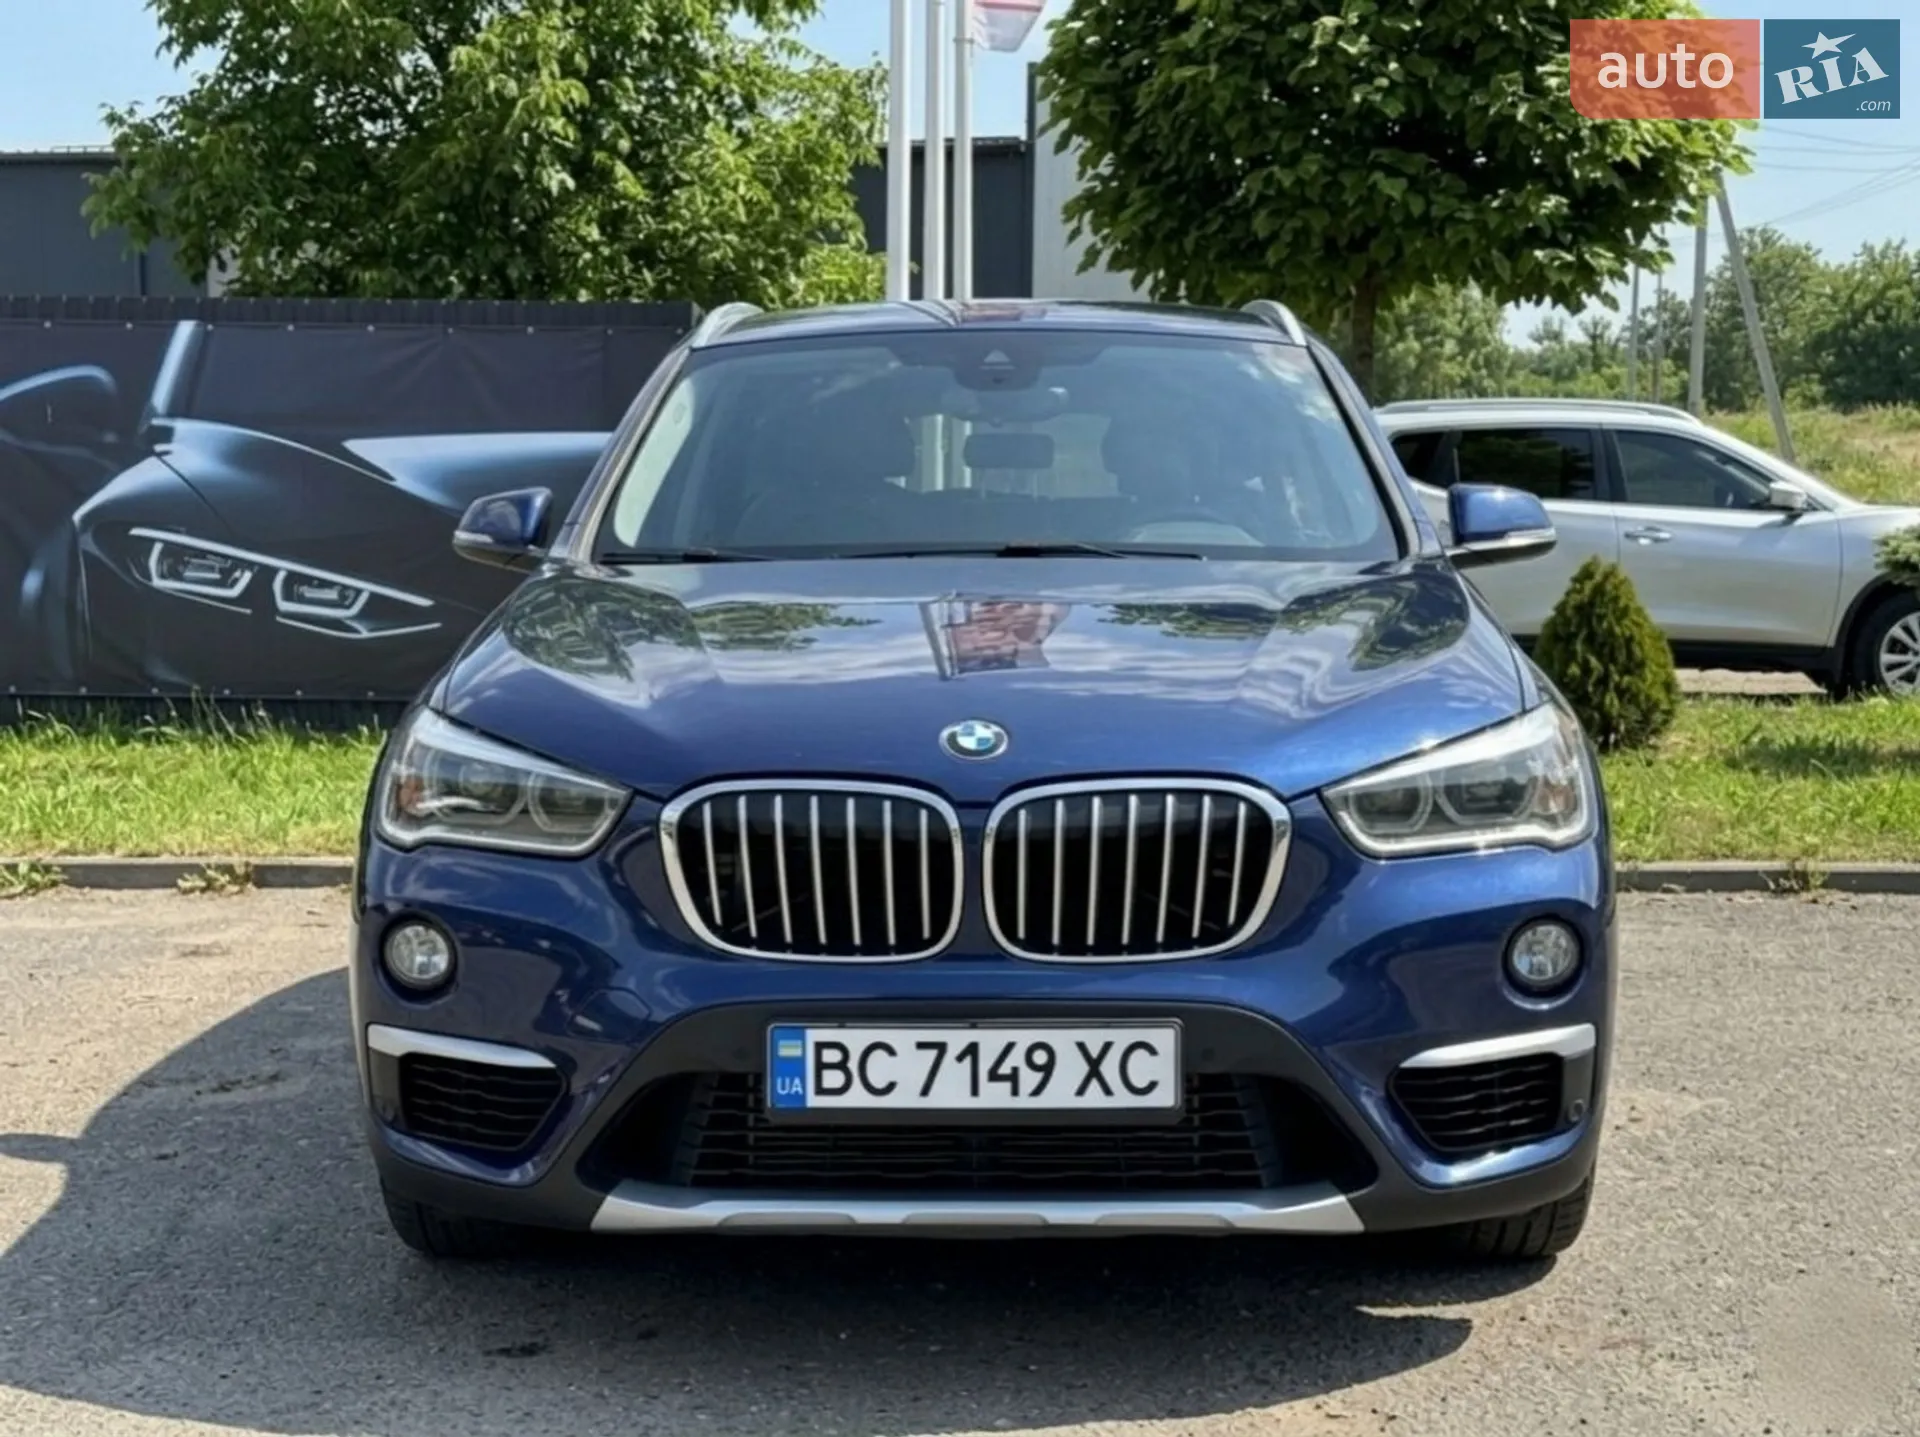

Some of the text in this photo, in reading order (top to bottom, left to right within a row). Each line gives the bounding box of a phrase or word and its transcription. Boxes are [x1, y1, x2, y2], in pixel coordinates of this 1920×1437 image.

[776, 1076, 804, 1095] UA
[813, 1041, 1160, 1097] BC 7149 XC
